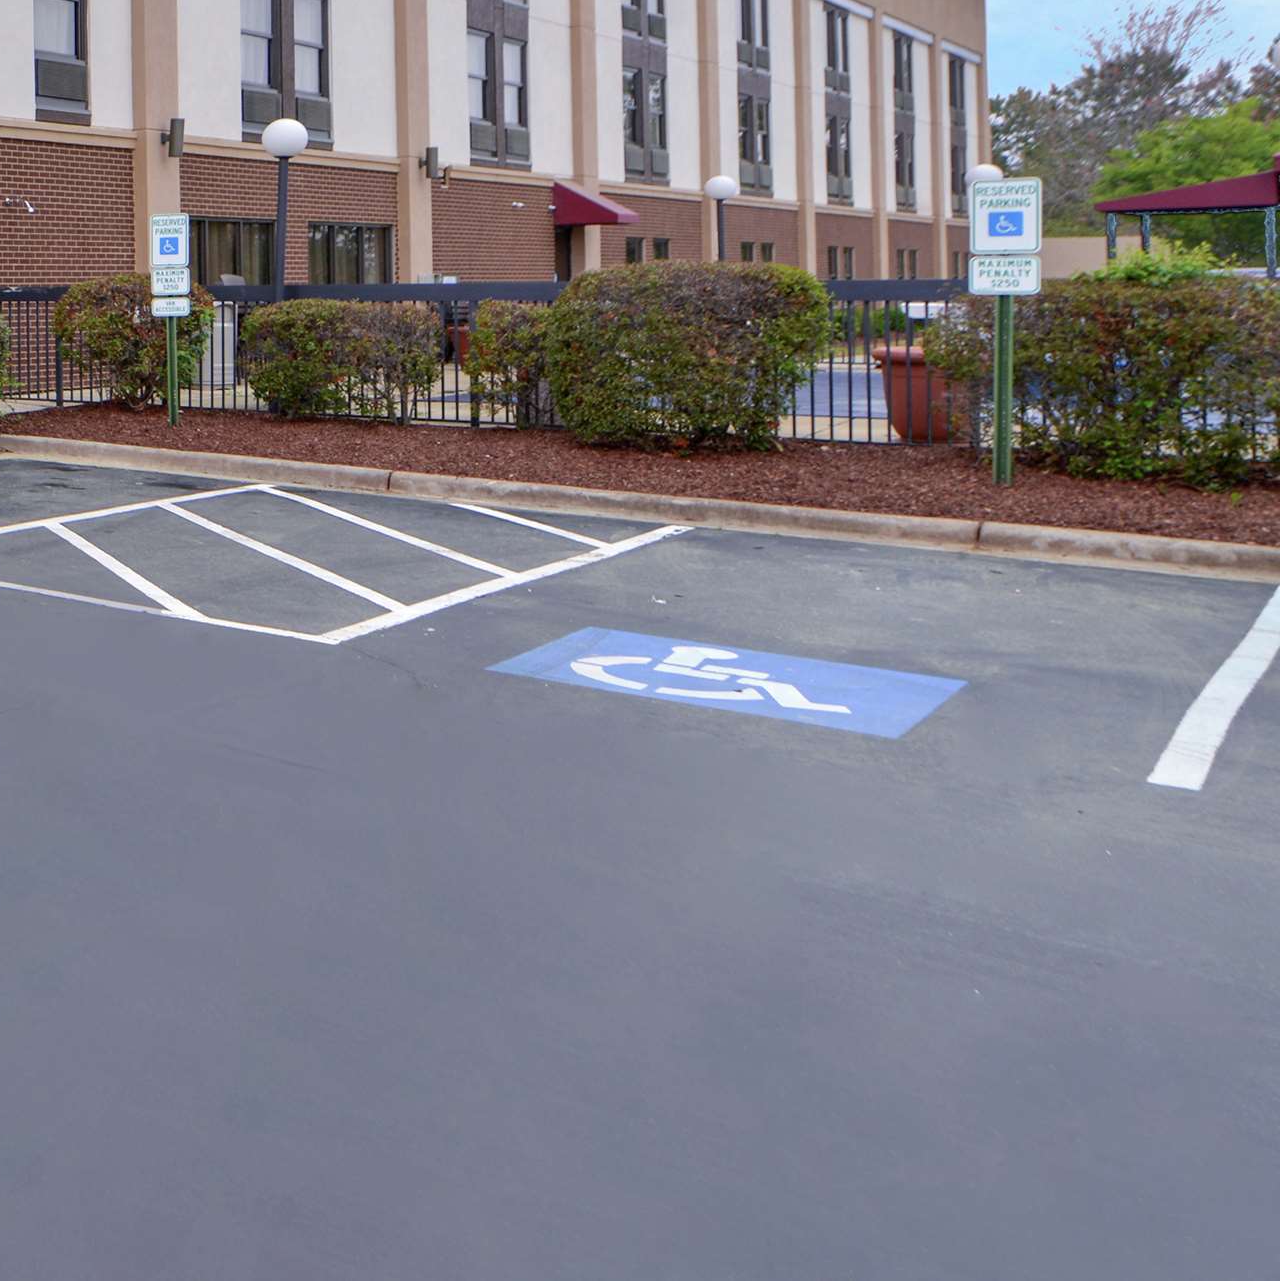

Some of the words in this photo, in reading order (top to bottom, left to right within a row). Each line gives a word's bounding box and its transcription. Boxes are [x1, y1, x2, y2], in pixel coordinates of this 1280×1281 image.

[975, 184, 1037, 196] RESERVED
[980, 197, 1032, 208] PARKING
[153, 218, 186, 227] RESERVED
[154, 227, 184, 236] PARKING
[978, 259, 1033, 268] MAXIMUM
[155, 269, 185, 277] MAXIMUM
[979, 269, 1032, 278] PENALTY
